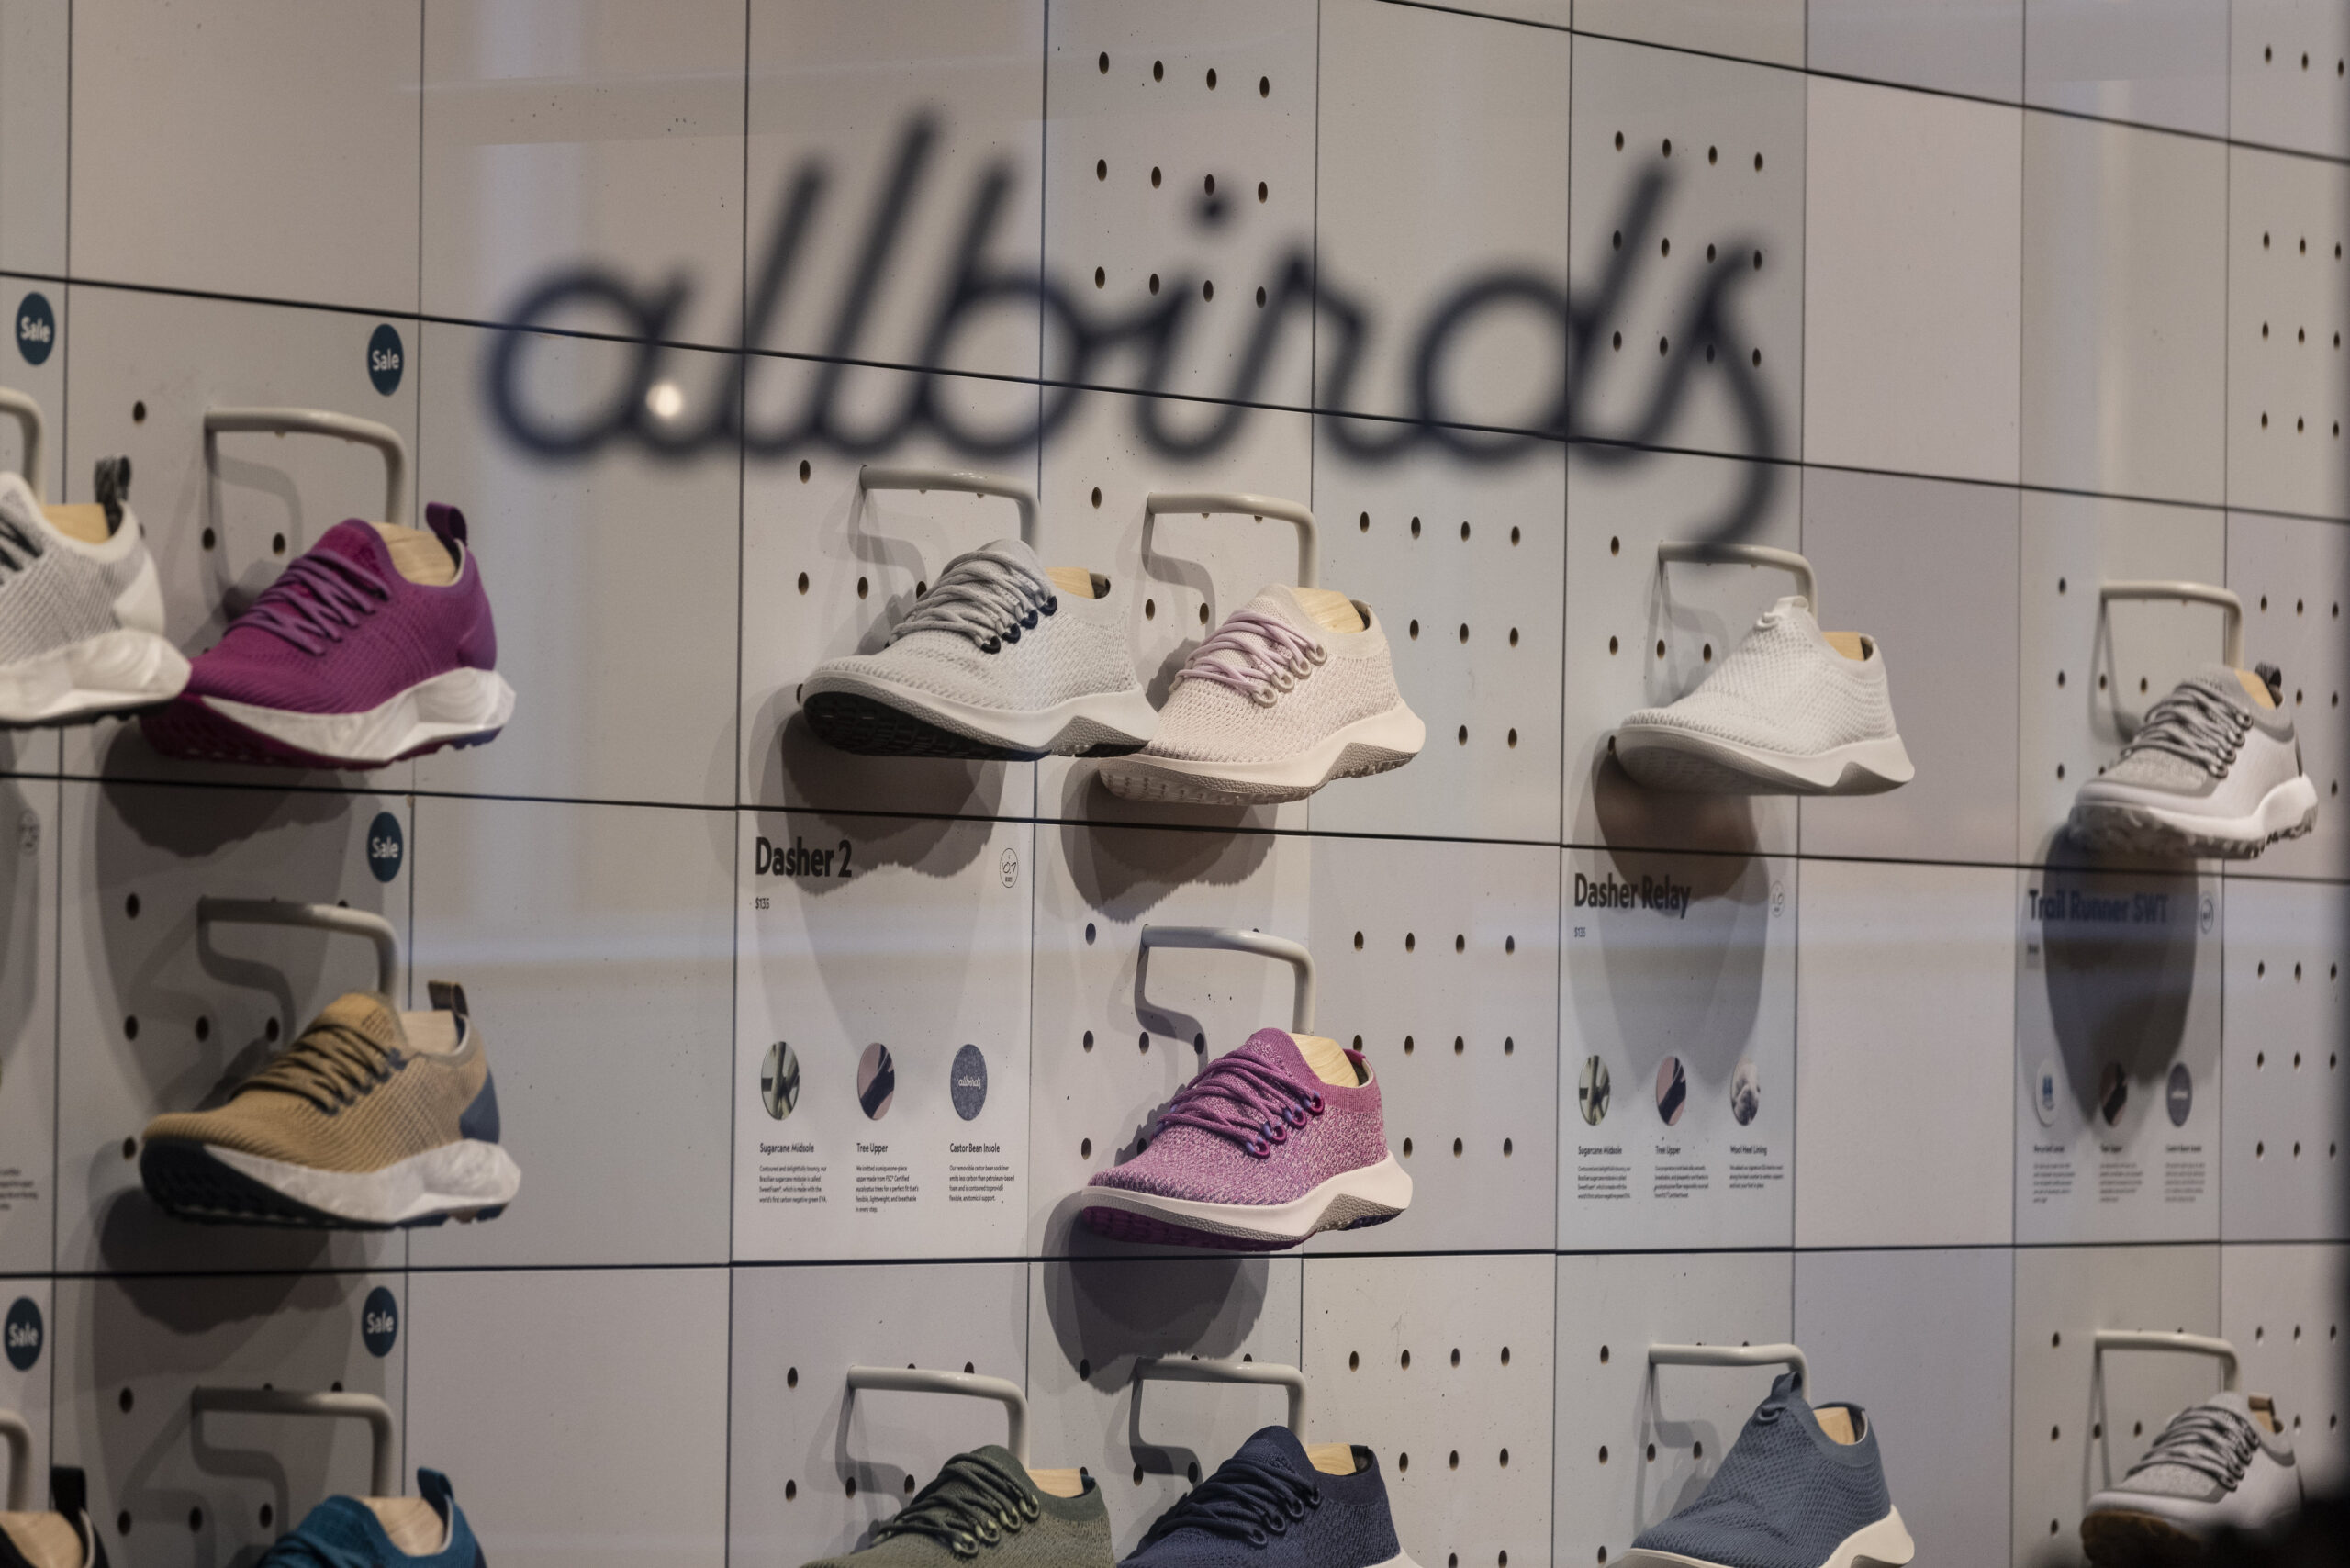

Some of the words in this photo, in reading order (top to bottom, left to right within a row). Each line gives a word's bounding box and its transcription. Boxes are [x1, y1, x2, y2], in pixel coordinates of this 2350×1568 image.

[20, 318, 50, 342] Sale
[484, 106, 1779, 557] allbirds
[372, 349, 399, 372] Sale
[372, 836, 399, 858] Sale
[755, 836, 834, 877] Dasher
[838, 839, 852, 878] 2
[755, 898, 769, 910] $135
[1574, 873, 1638, 909] Dasher
[1641, 875, 1691, 919] Relay
[2029, 890, 2065, 921] Trail
[2071, 891, 2130, 923] Runner
[2133, 893, 2168, 924] SWT
[759, 1143, 789, 1155] Sugarcane
[791, 1143, 814, 1153] Midsole
[856, 1143, 868, 1153] Tree
[869, 1143, 888, 1155] Upper
[950, 1143, 967, 1153] Castor
[968, 1143, 982, 1153] Bean
[983, 1143, 1000, 1153] Insole
[367, 1311, 394, 1334] Sale
[9, 1323, 38, 1347] Sale
